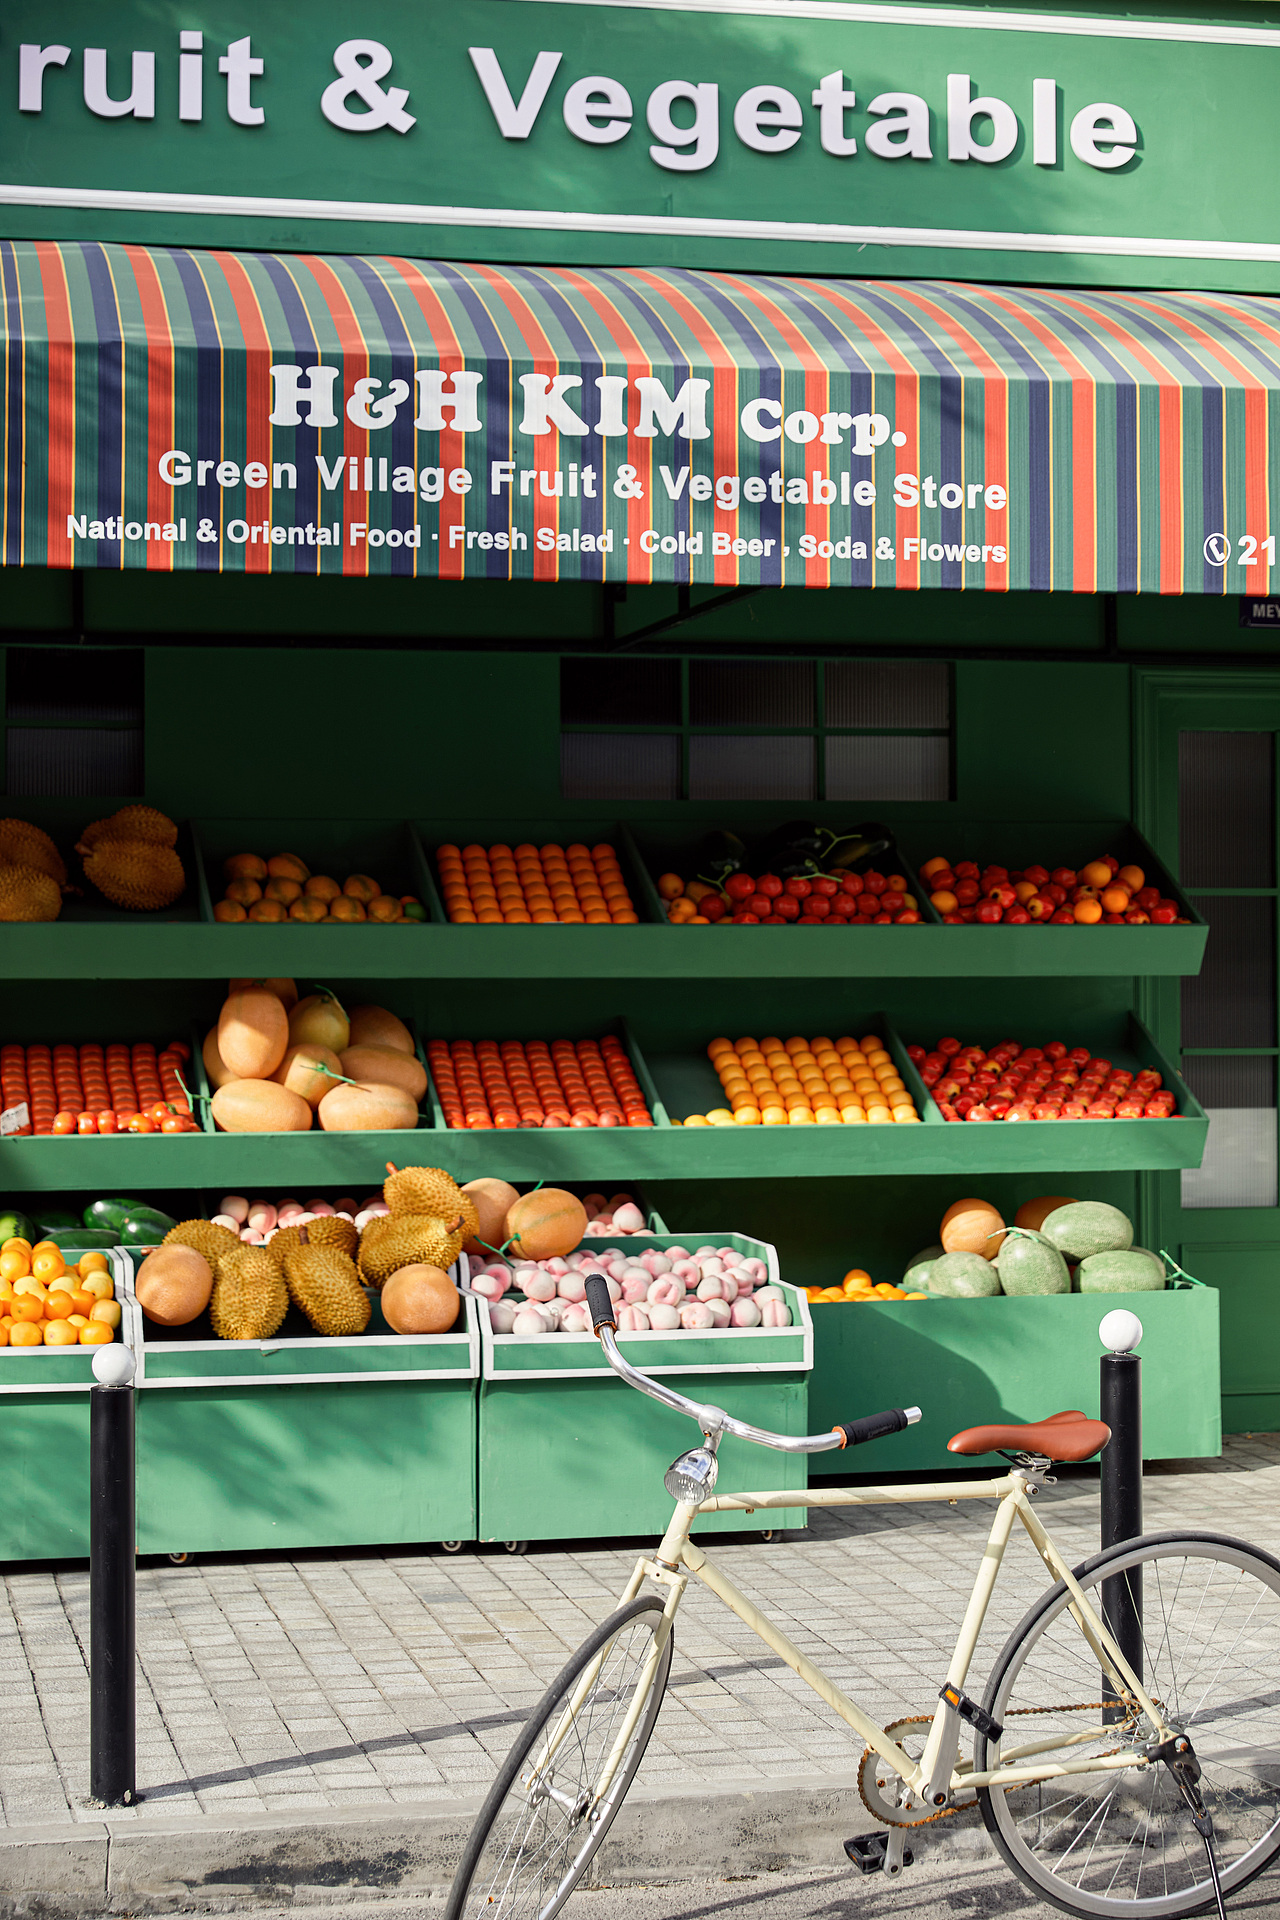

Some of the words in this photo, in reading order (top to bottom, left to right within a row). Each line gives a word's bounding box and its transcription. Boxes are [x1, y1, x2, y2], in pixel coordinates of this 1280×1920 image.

[18, 31, 265, 125] ruit
[321, 39, 416, 133] &
[469, 47, 1138, 171] Vegetable
[269, 365, 484, 432] H&H
[519, 373, 711, 439] KIM
[741, 398, 907, 456] Corp.
[158, 450, 297, 489] Green
[314, 456, 473, 502] Village
[491, 461, 597, 498] Fruit
[613, 464, 645, 500] &
[659, 466, 877, 511] Vegetable
[893, 474, 1007, 510] Store
[67, 515, 187, 542] National
[196, 518, 218, 543] &
[226, 519, 340, 546] Oriental
[350, 523, 421, 548] Food
[449, 525, 528, 550] Fresh
[536, 528, 614, 552] Salad
[640, 530, 703, 555] Cold
[799, 534, 868, 560] Soda
[875, 536, 896, 561] &
[904, 538, 1007, 563] Flowers
[1237, 535, 1276, 567] 21
